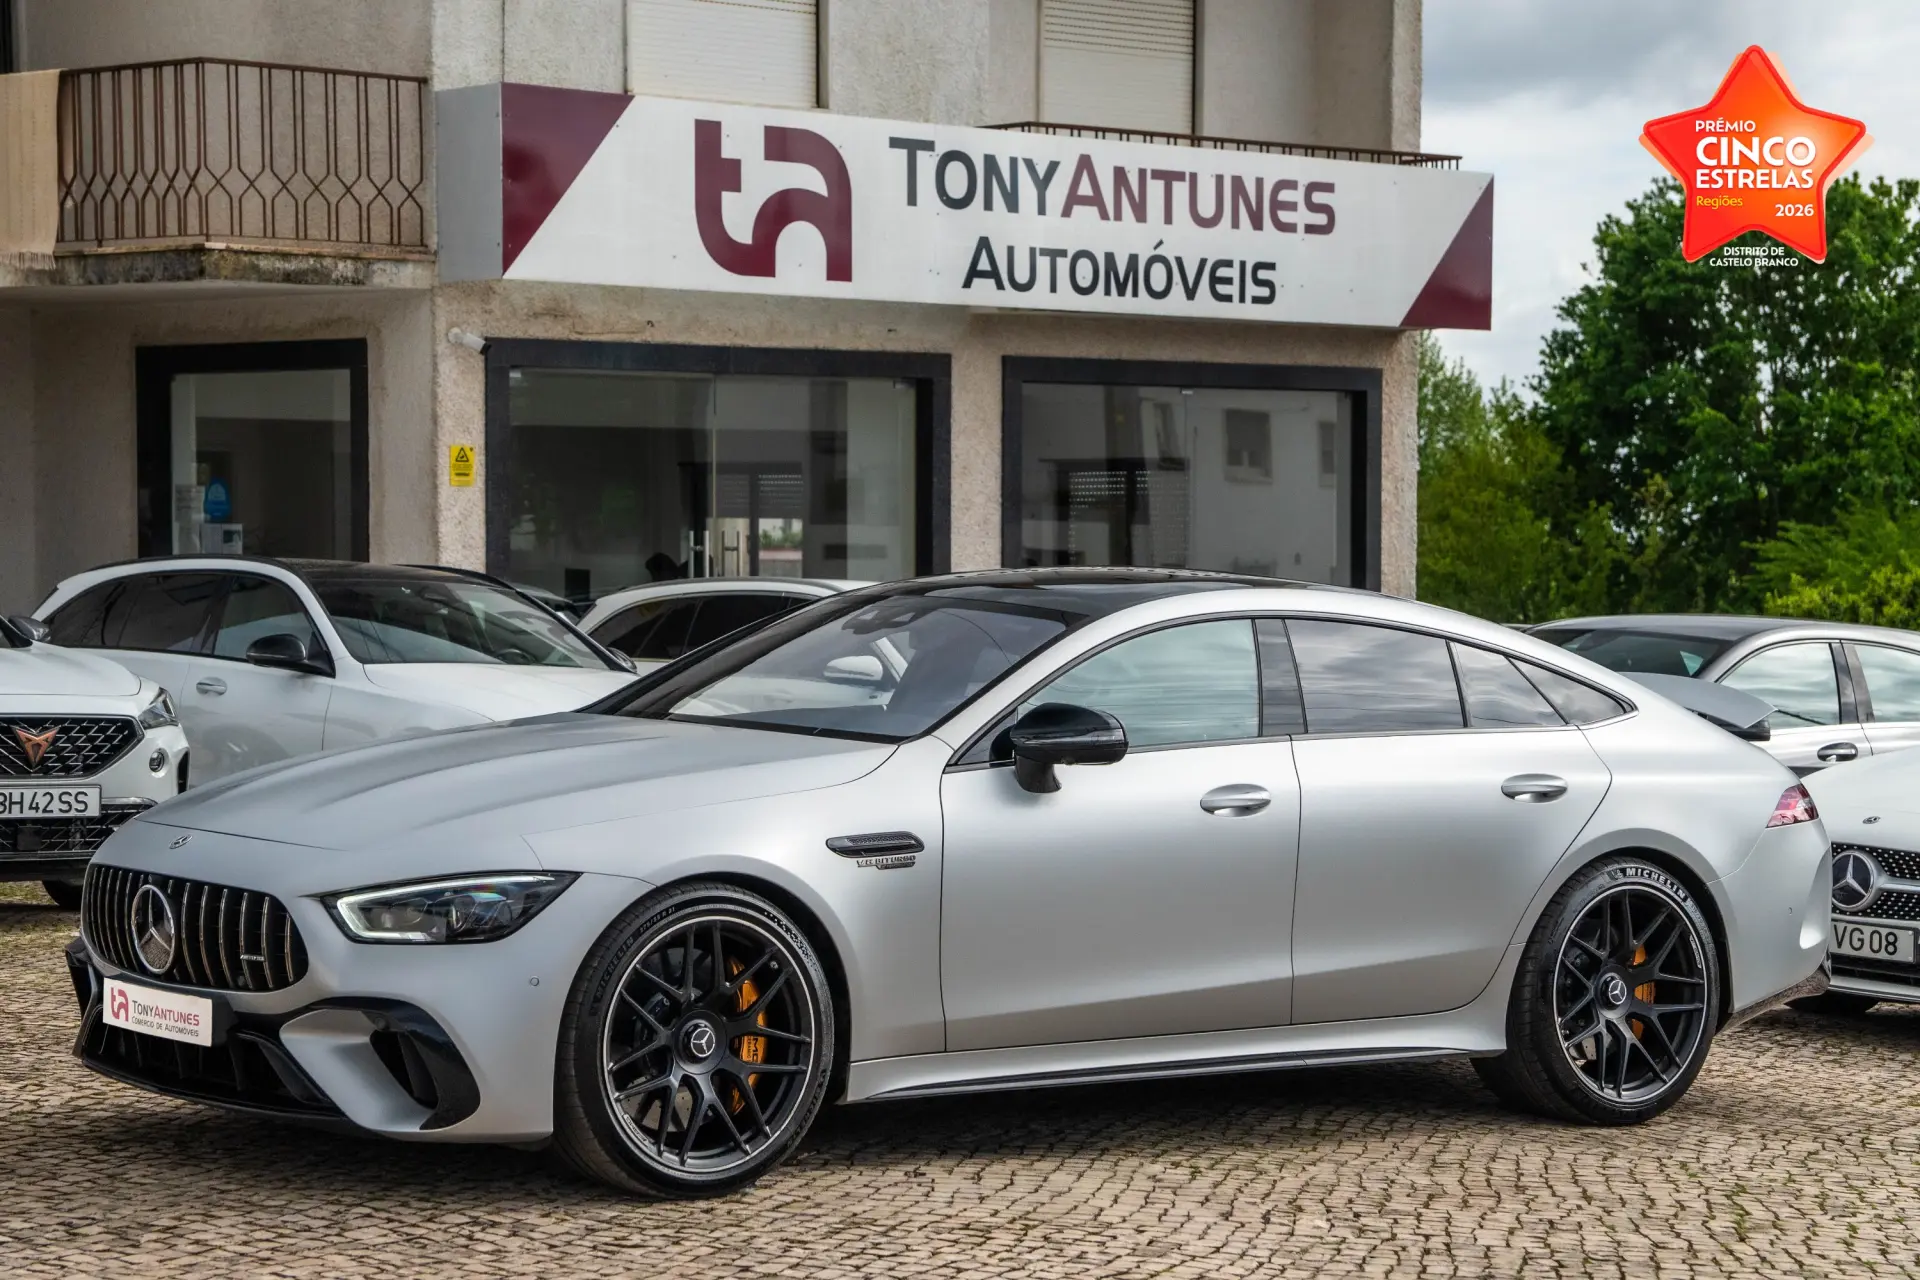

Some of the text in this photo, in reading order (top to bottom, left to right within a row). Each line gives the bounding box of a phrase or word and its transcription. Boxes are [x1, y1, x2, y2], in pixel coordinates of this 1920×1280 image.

[961, 236, 1277, 305] AUTOMÓVEIS
[28, 791, 54, 814] 42
[58, 791, 89, 813] SS
[1626, 867, 1686, 899] MICHELIN
[1833, 924, 1898, 956] VG 08
